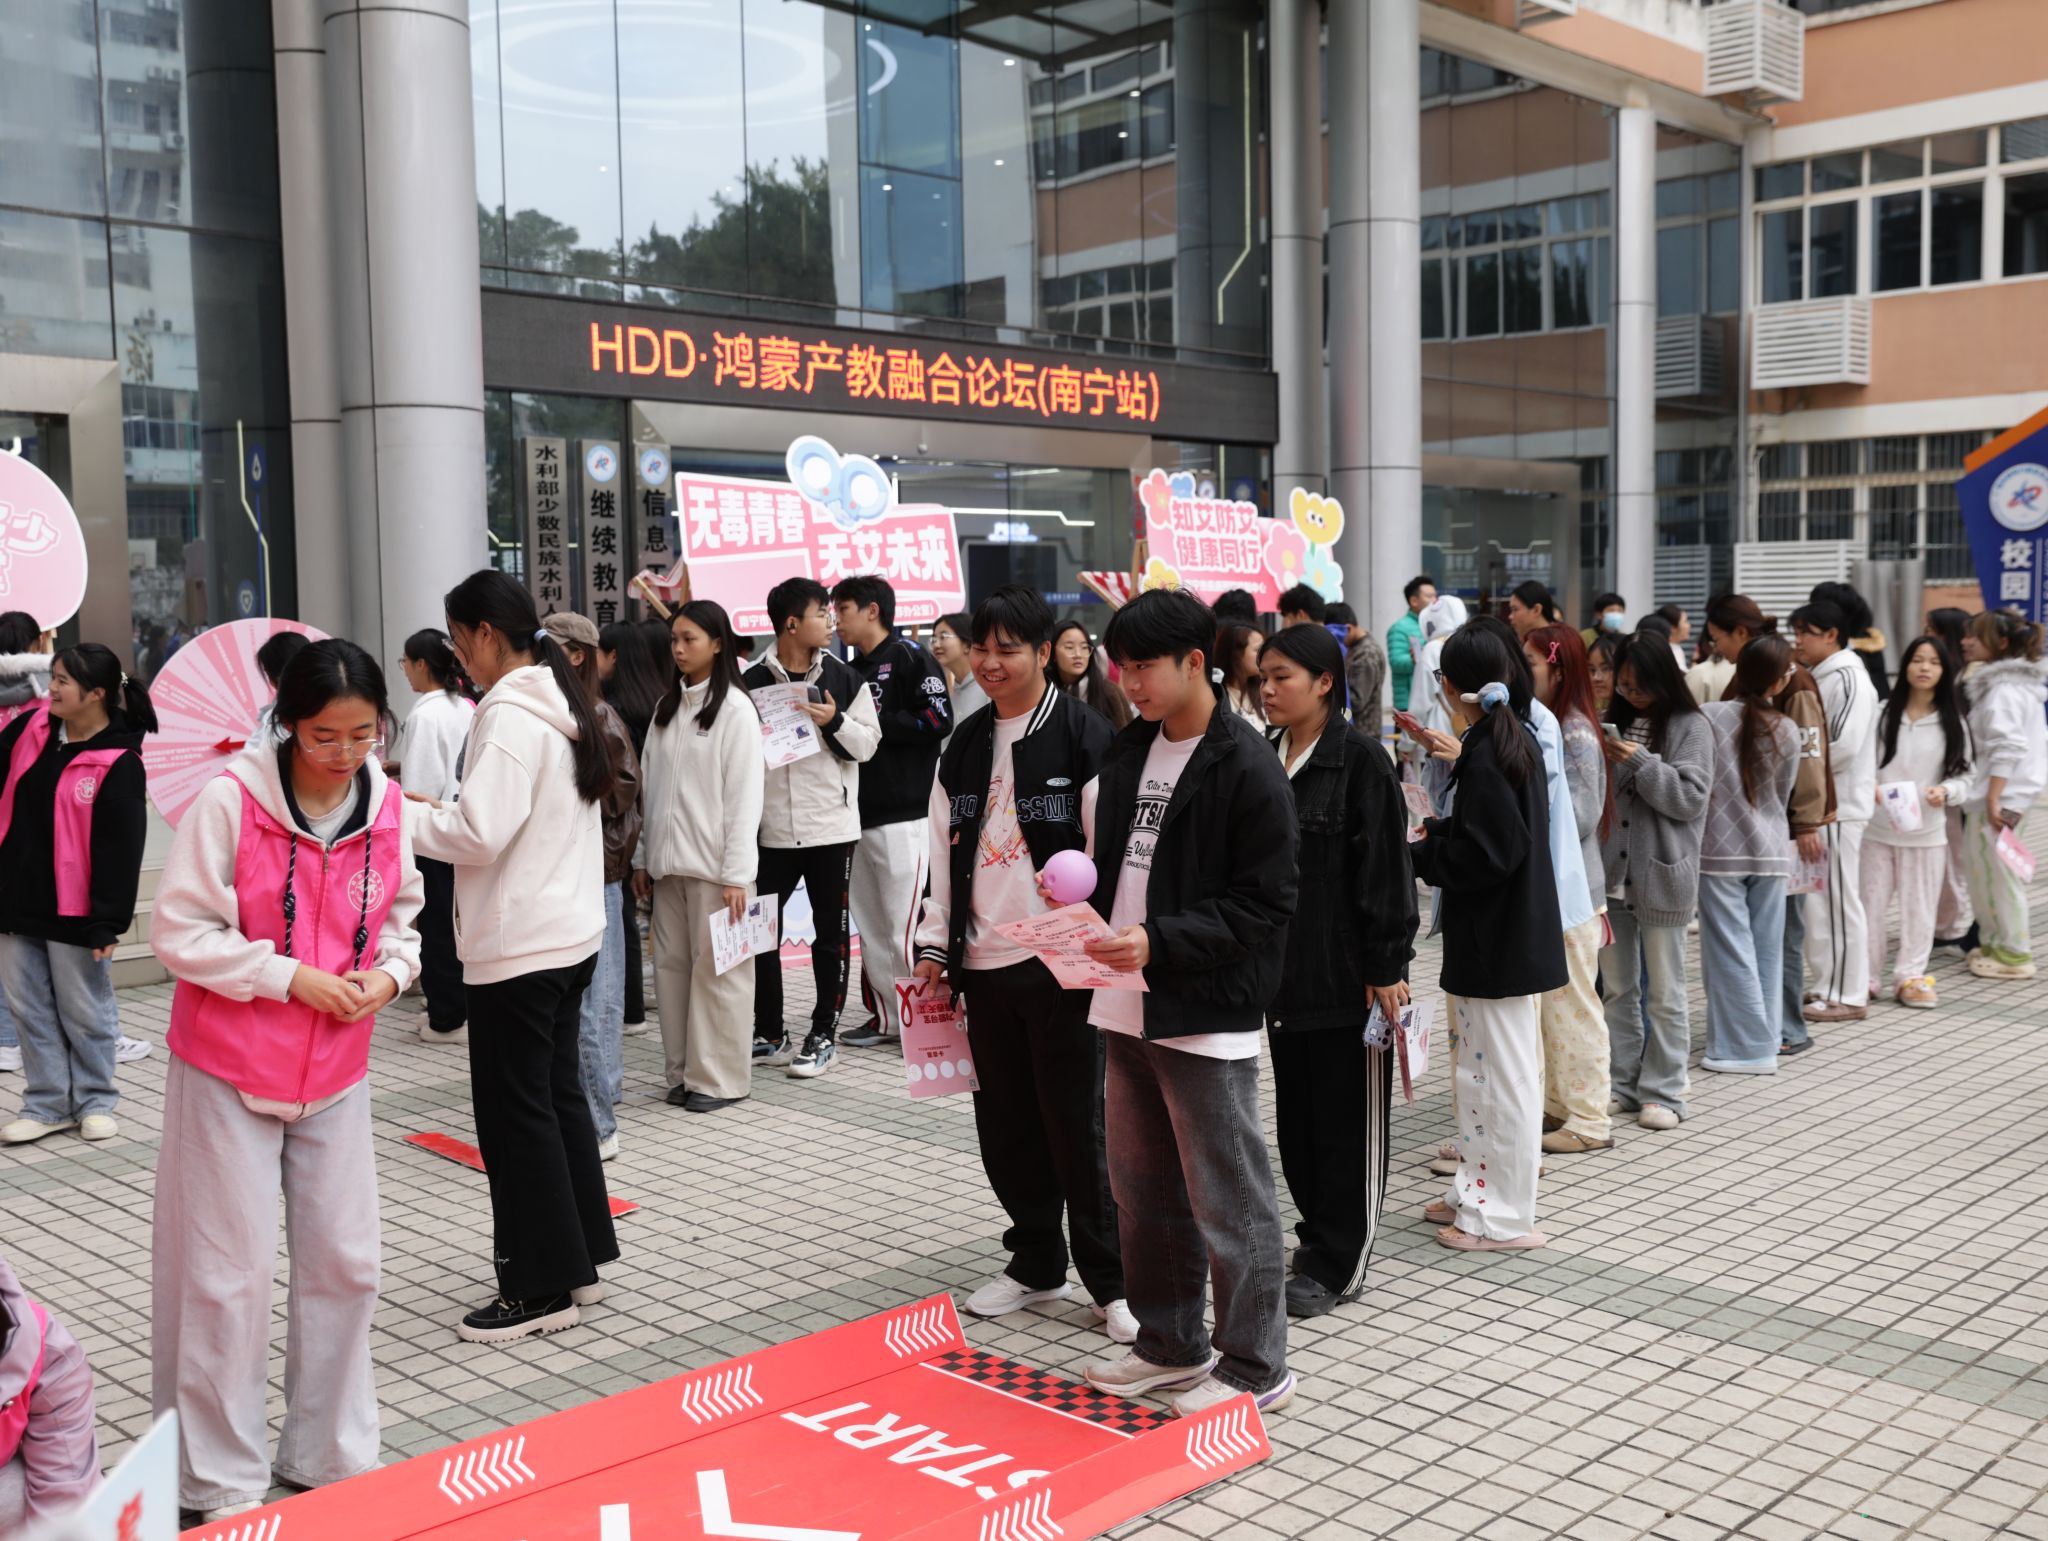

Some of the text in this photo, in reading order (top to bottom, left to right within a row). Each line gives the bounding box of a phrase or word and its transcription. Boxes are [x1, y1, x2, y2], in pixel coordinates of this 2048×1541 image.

[590, 321, 1160, 422] HDD·鸿蒙产教融合论坛(南宁站)
[688, 486, 805, 549] 无毒青春
[1172, 501, 1256, 535] 知艾防艾
[817, 524, 953, 582] 无艾未来
[1176, 535, 1261, 571] 健康同行
